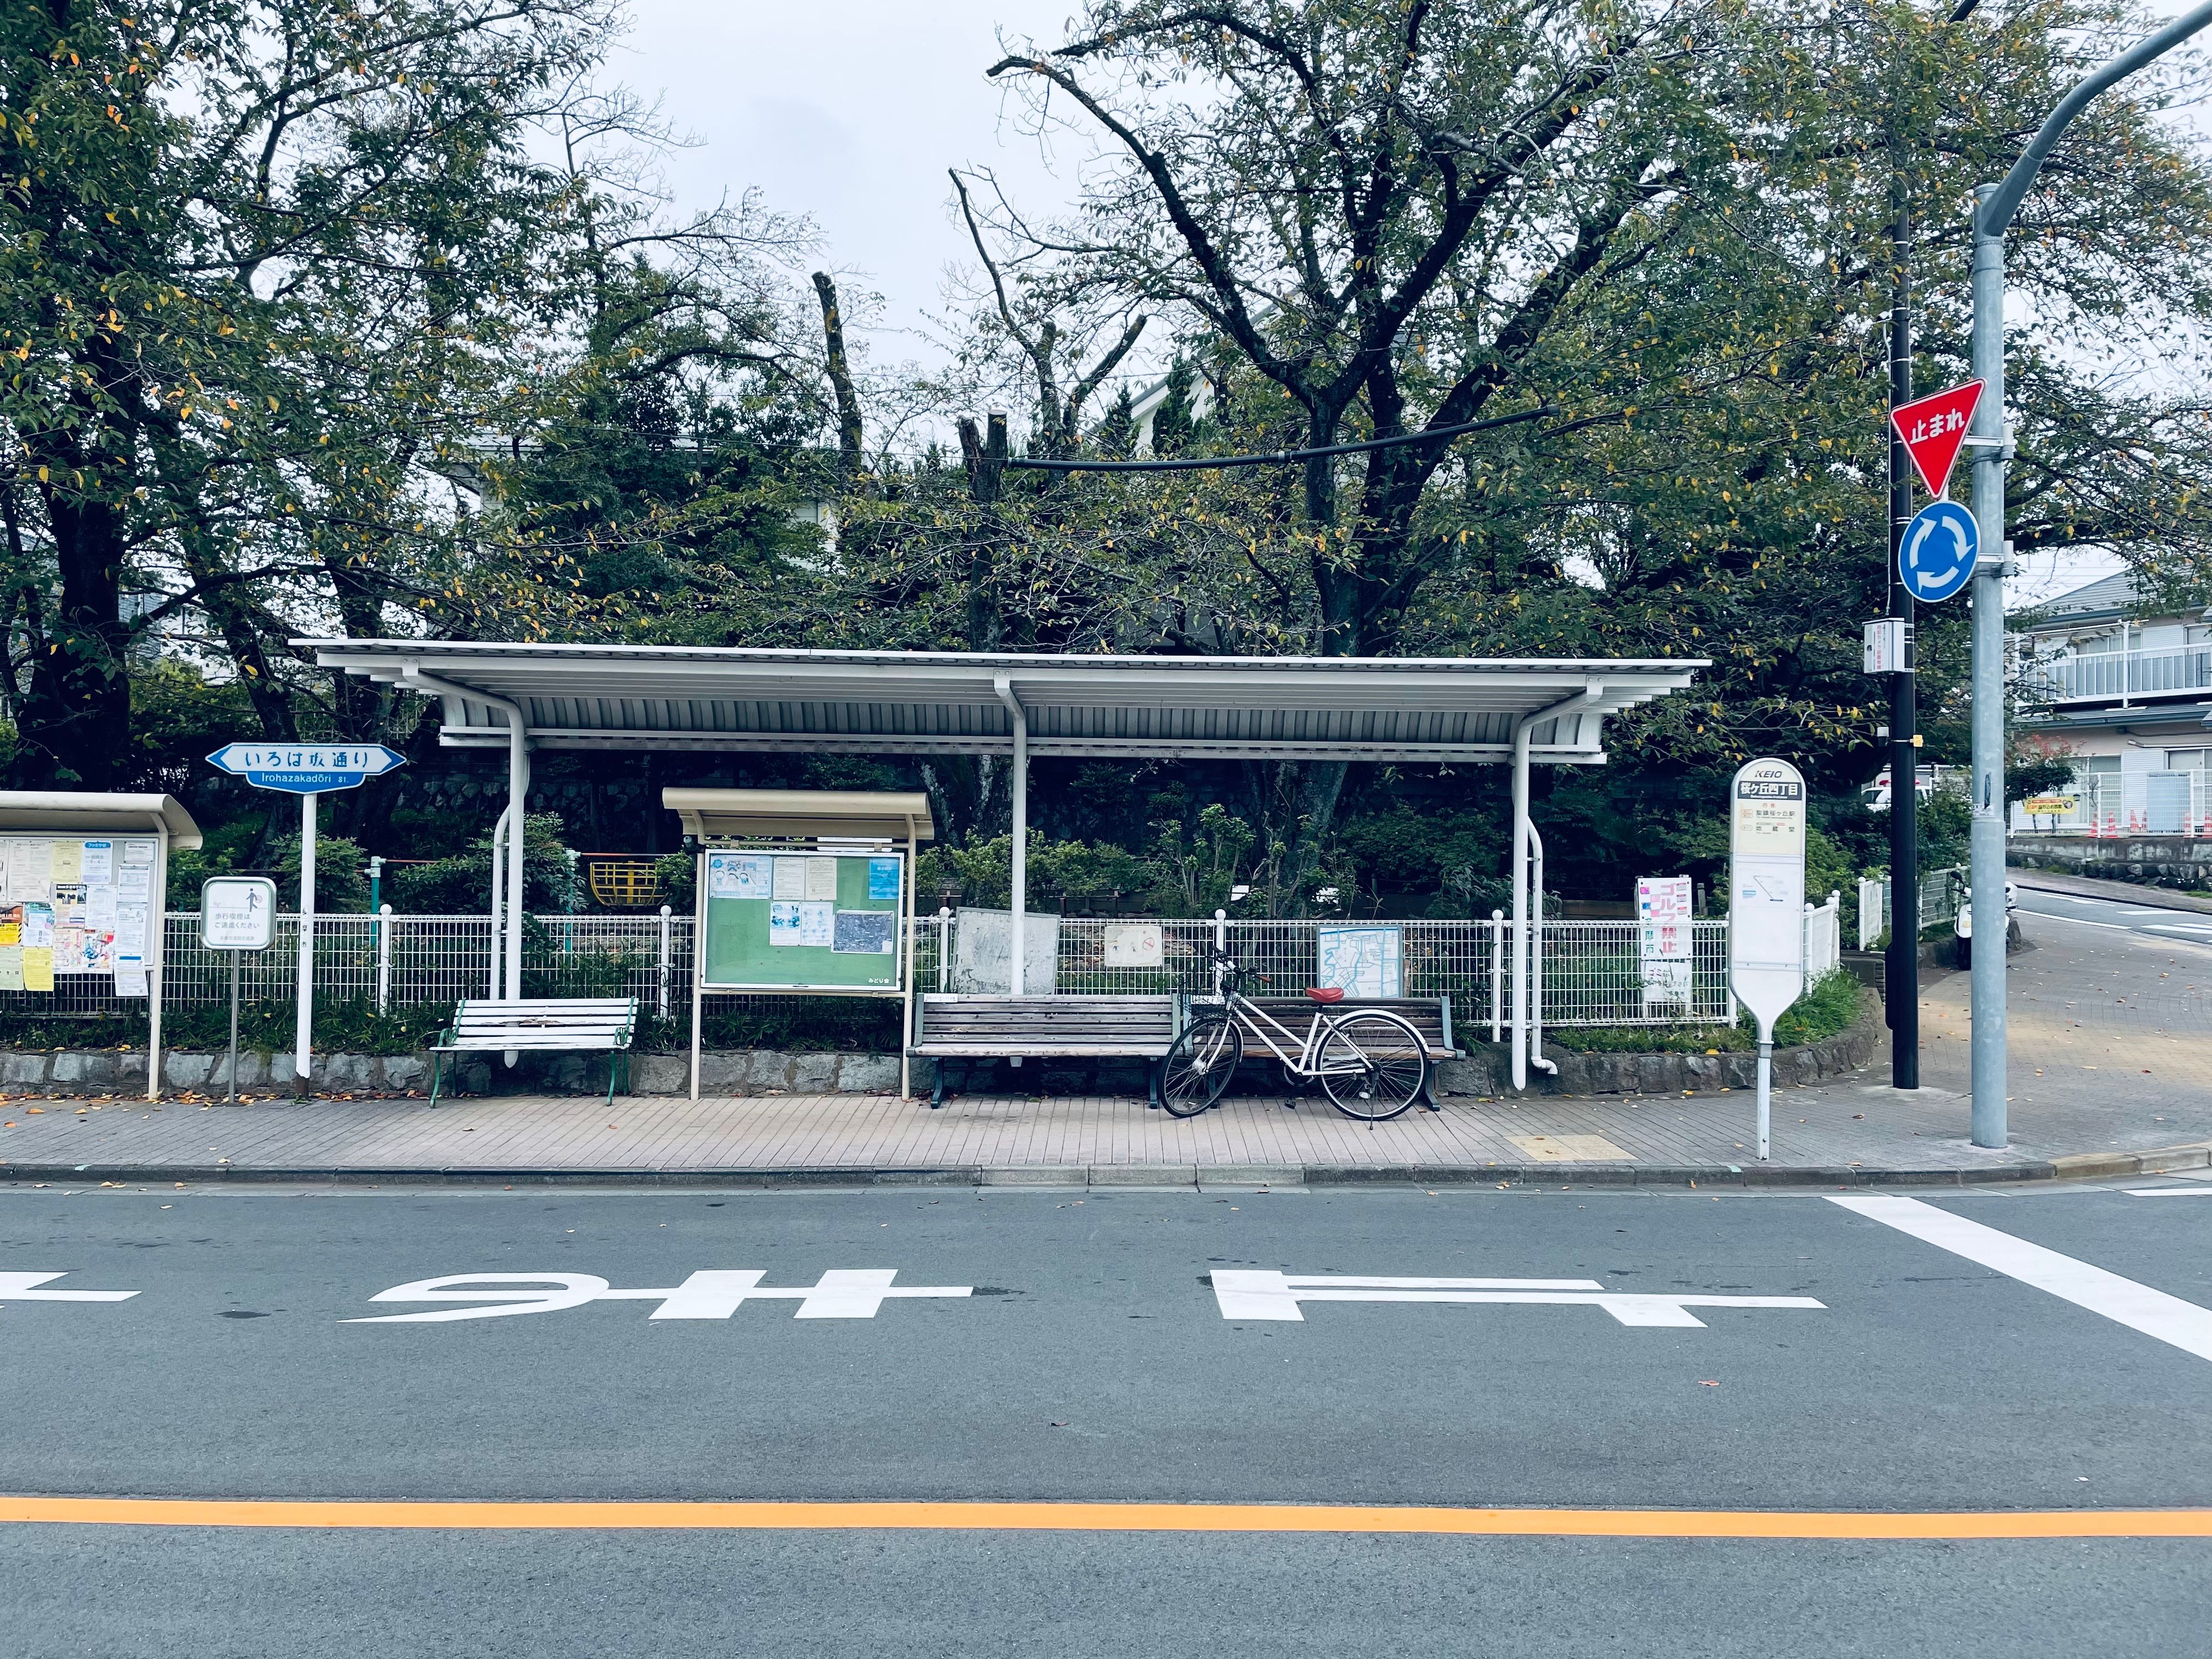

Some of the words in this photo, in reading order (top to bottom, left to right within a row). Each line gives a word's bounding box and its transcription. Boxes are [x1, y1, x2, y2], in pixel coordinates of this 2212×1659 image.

[1910, 408, 1965, 444] 止まれ
[245, 752, 368, 768] いろは坂通り
[262, 772, 331, 783] Irohazakadōri
[1754, 770, 1783, 778] KEIO
[1660, 883, 1677, 953] ゴルフ禁止
